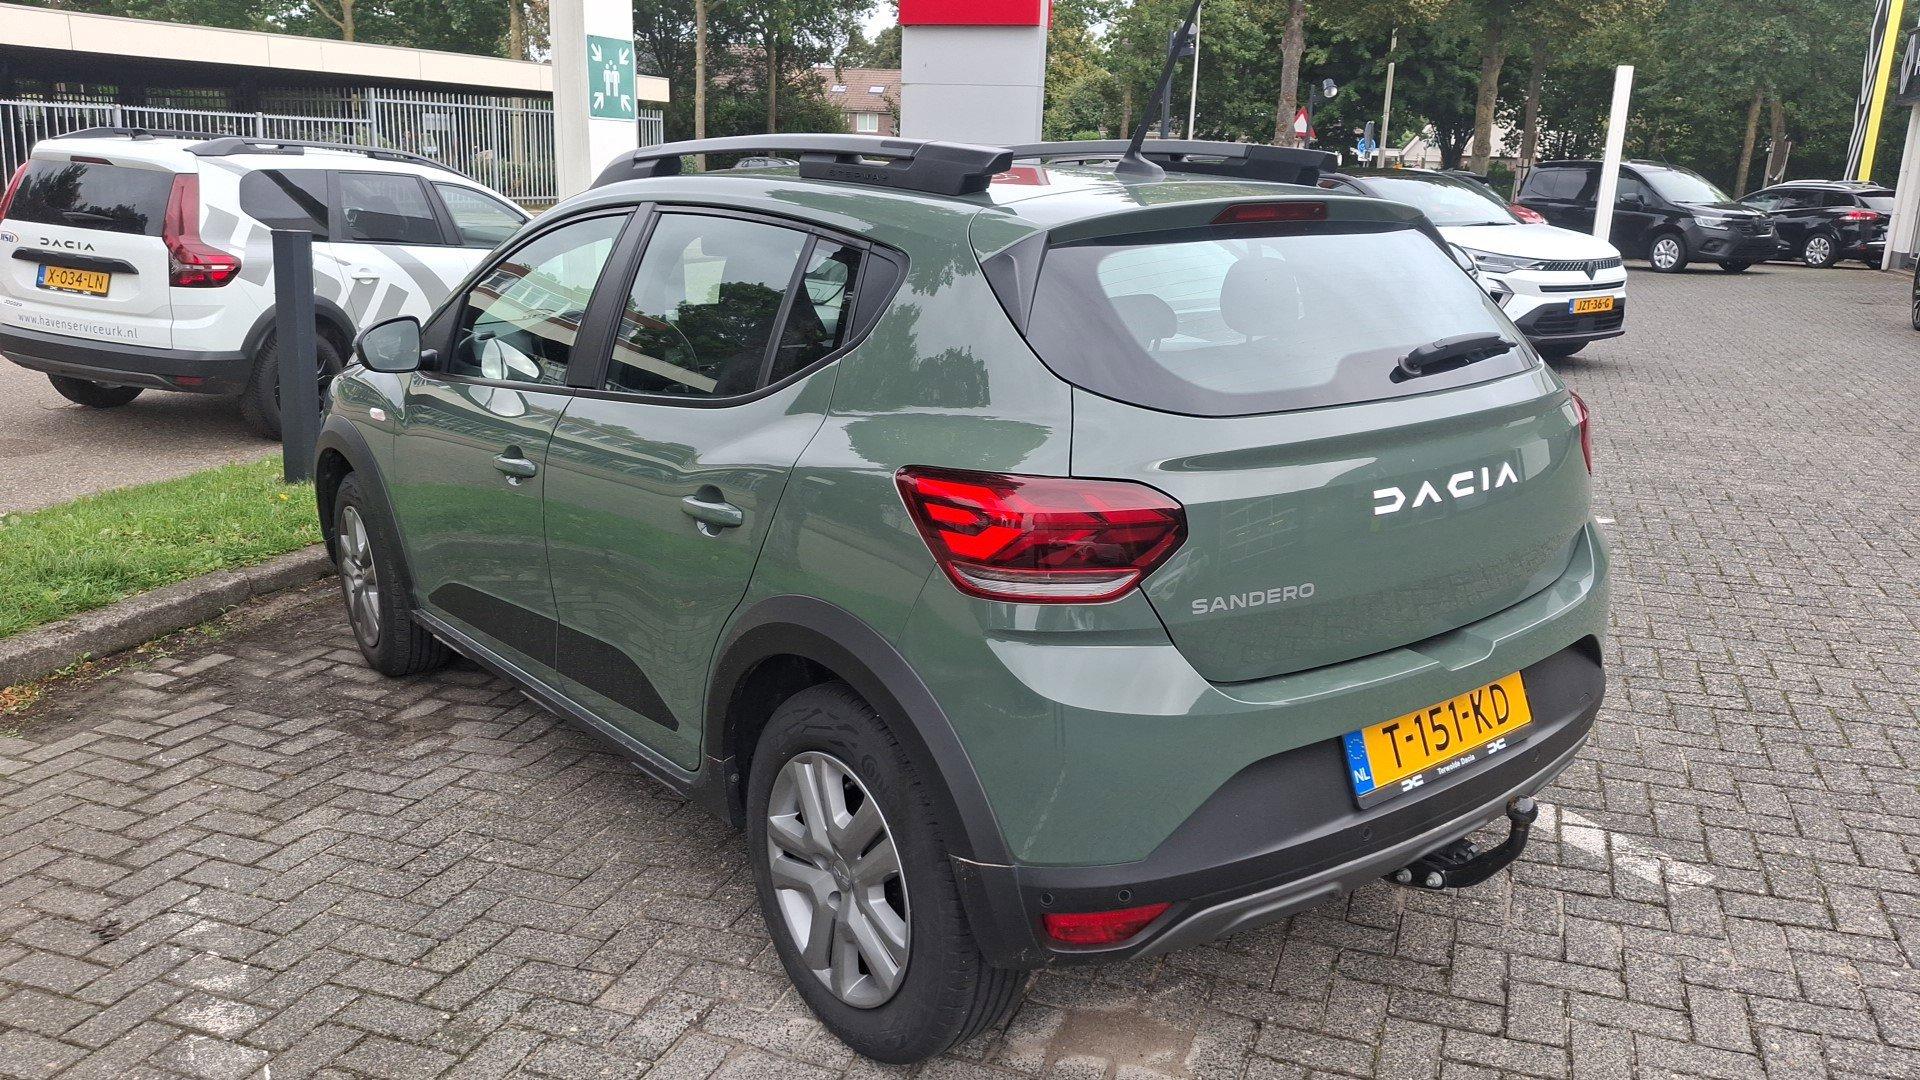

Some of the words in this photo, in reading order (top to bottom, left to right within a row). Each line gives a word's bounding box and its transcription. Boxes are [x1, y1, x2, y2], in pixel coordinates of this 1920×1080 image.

[40, 237, 95, 251] DACIA
[48, 269, 104, 290] X-034-LN
[1577, 299, 1609, 311] JZT-36-G
[18, 313, 138, 339] www.havenserviceurk.nl
[1373, 461, 1519, 516] DACIA
[1191, 582, 1316, 615] SANDERO
[1382, 683, 1509, 768] T-151-KD
[1354, 767, 1371, 784] NL
